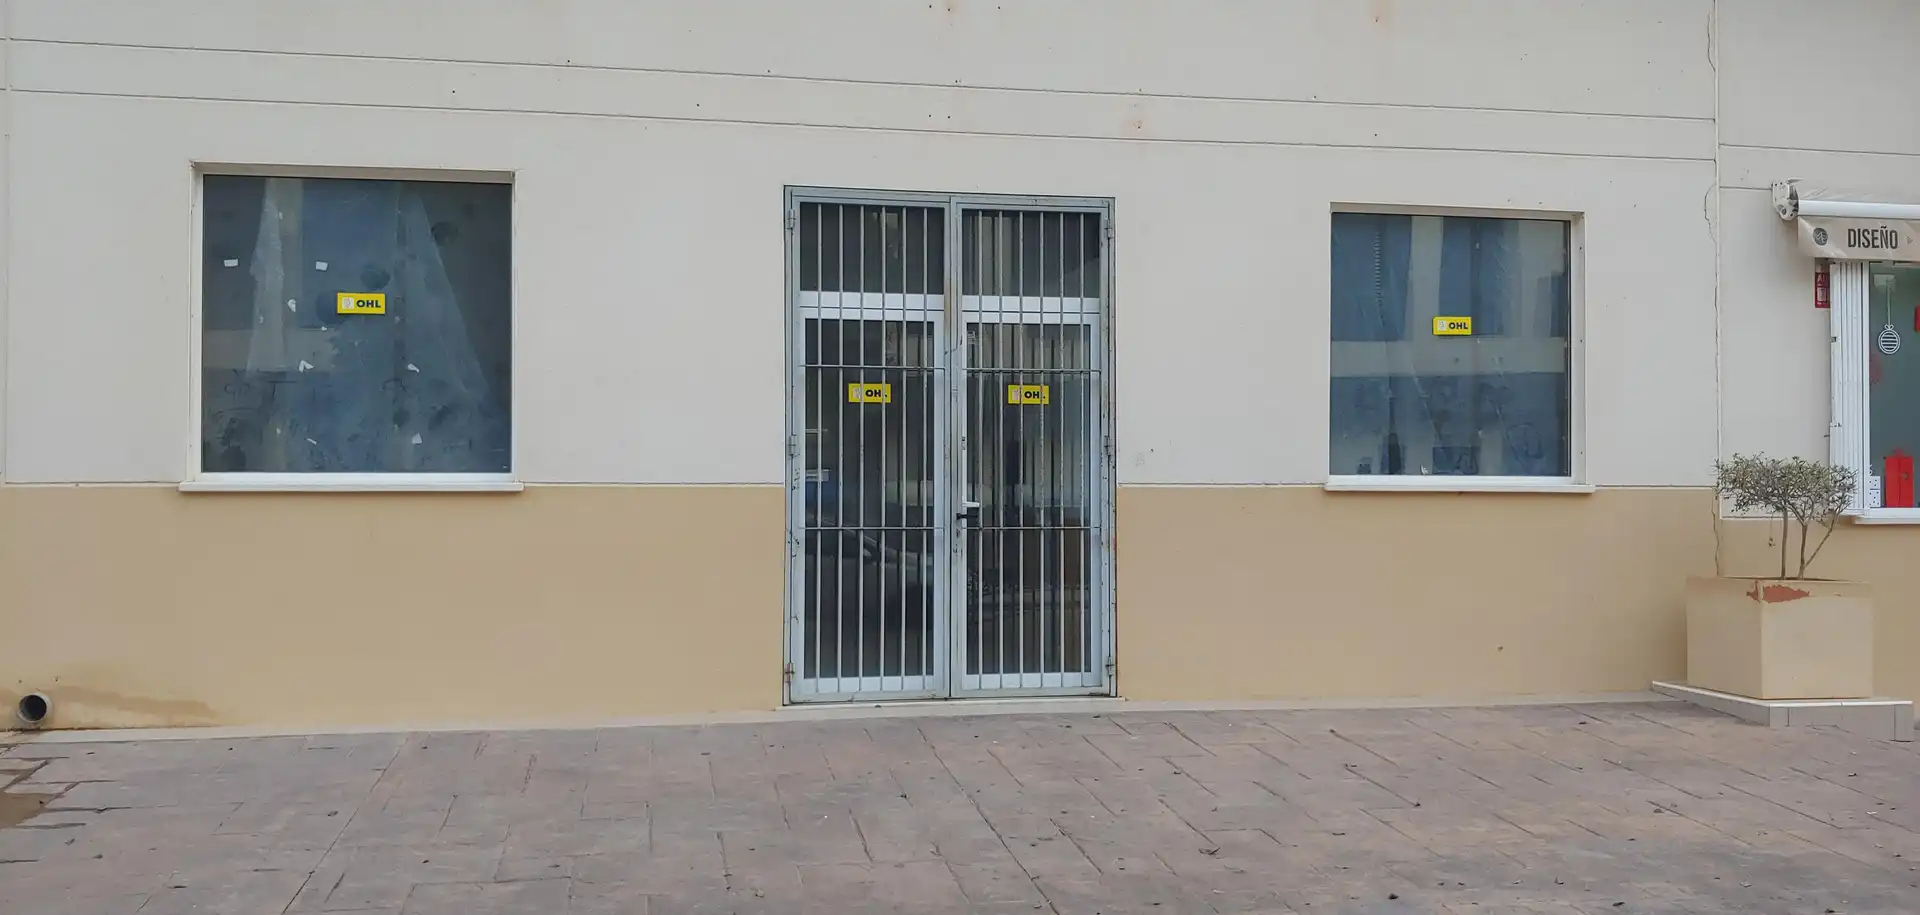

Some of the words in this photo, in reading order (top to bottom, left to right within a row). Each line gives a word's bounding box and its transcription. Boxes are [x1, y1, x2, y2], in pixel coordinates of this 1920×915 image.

[1847, 225, 1899, 249] DISEÑO
[356, 299, 381, 308] OHL
[1448, 322, 1468, 330] OHL
